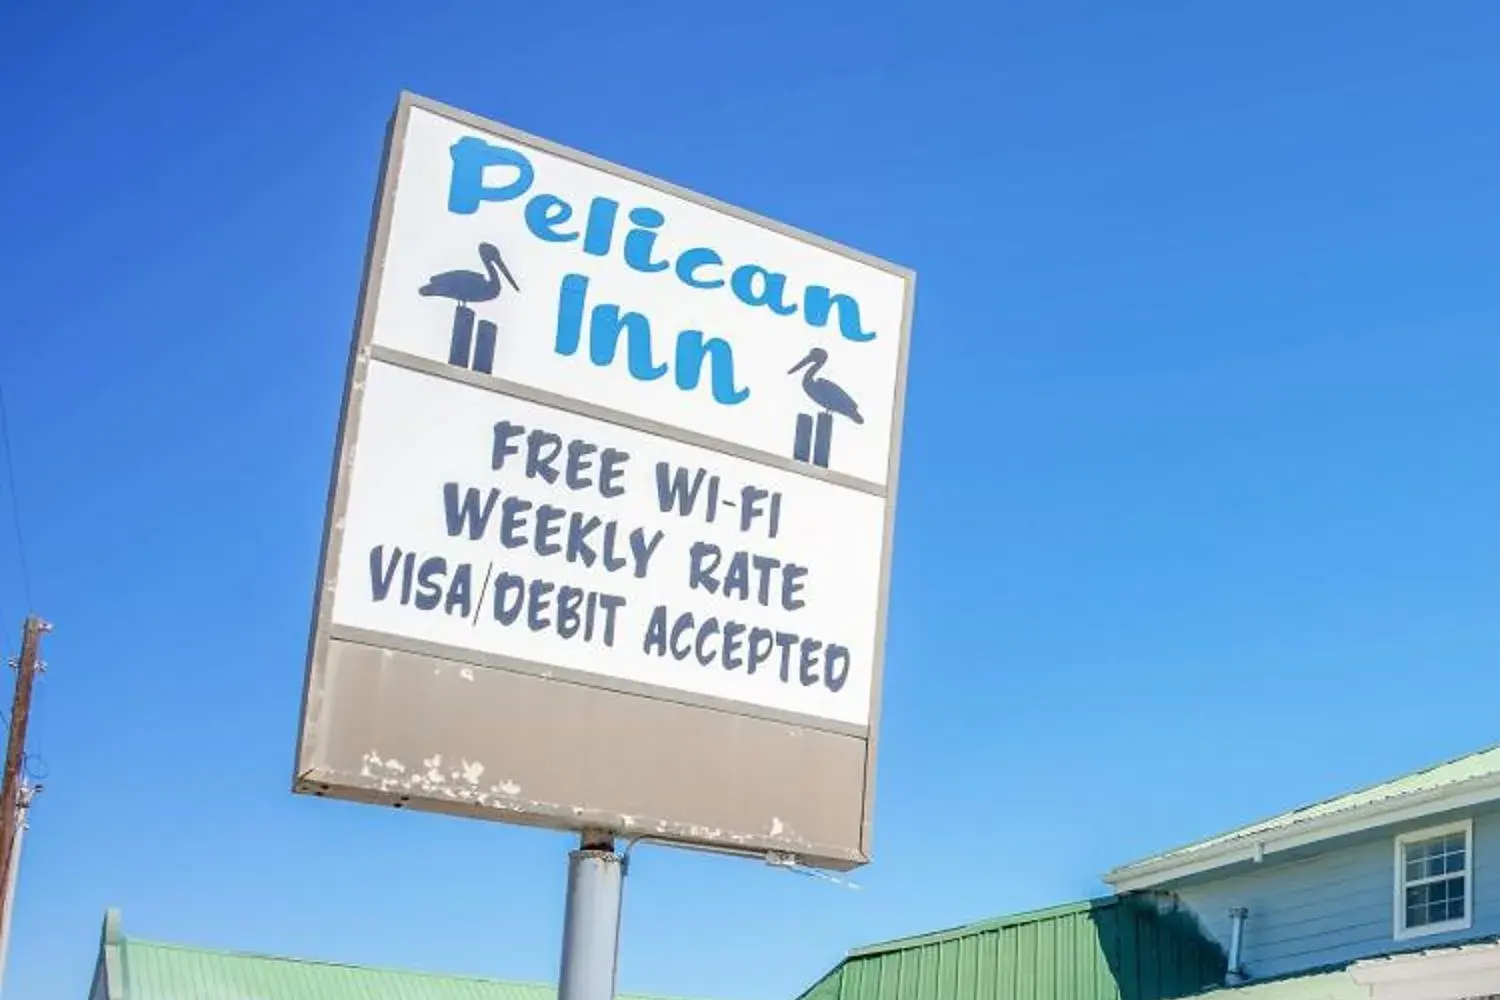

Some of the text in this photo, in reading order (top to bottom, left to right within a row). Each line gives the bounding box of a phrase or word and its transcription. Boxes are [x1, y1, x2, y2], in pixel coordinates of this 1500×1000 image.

[448, 136, 877, 342] Pelican
[554, 274, 751, 406] Inn
[492, 421, 782, 539] FREE WI-FI
[443, 482, 809, 611] WEEKLY RATE
[369, 545, 851, 693] VISA/DEBIT ACCEPTED
